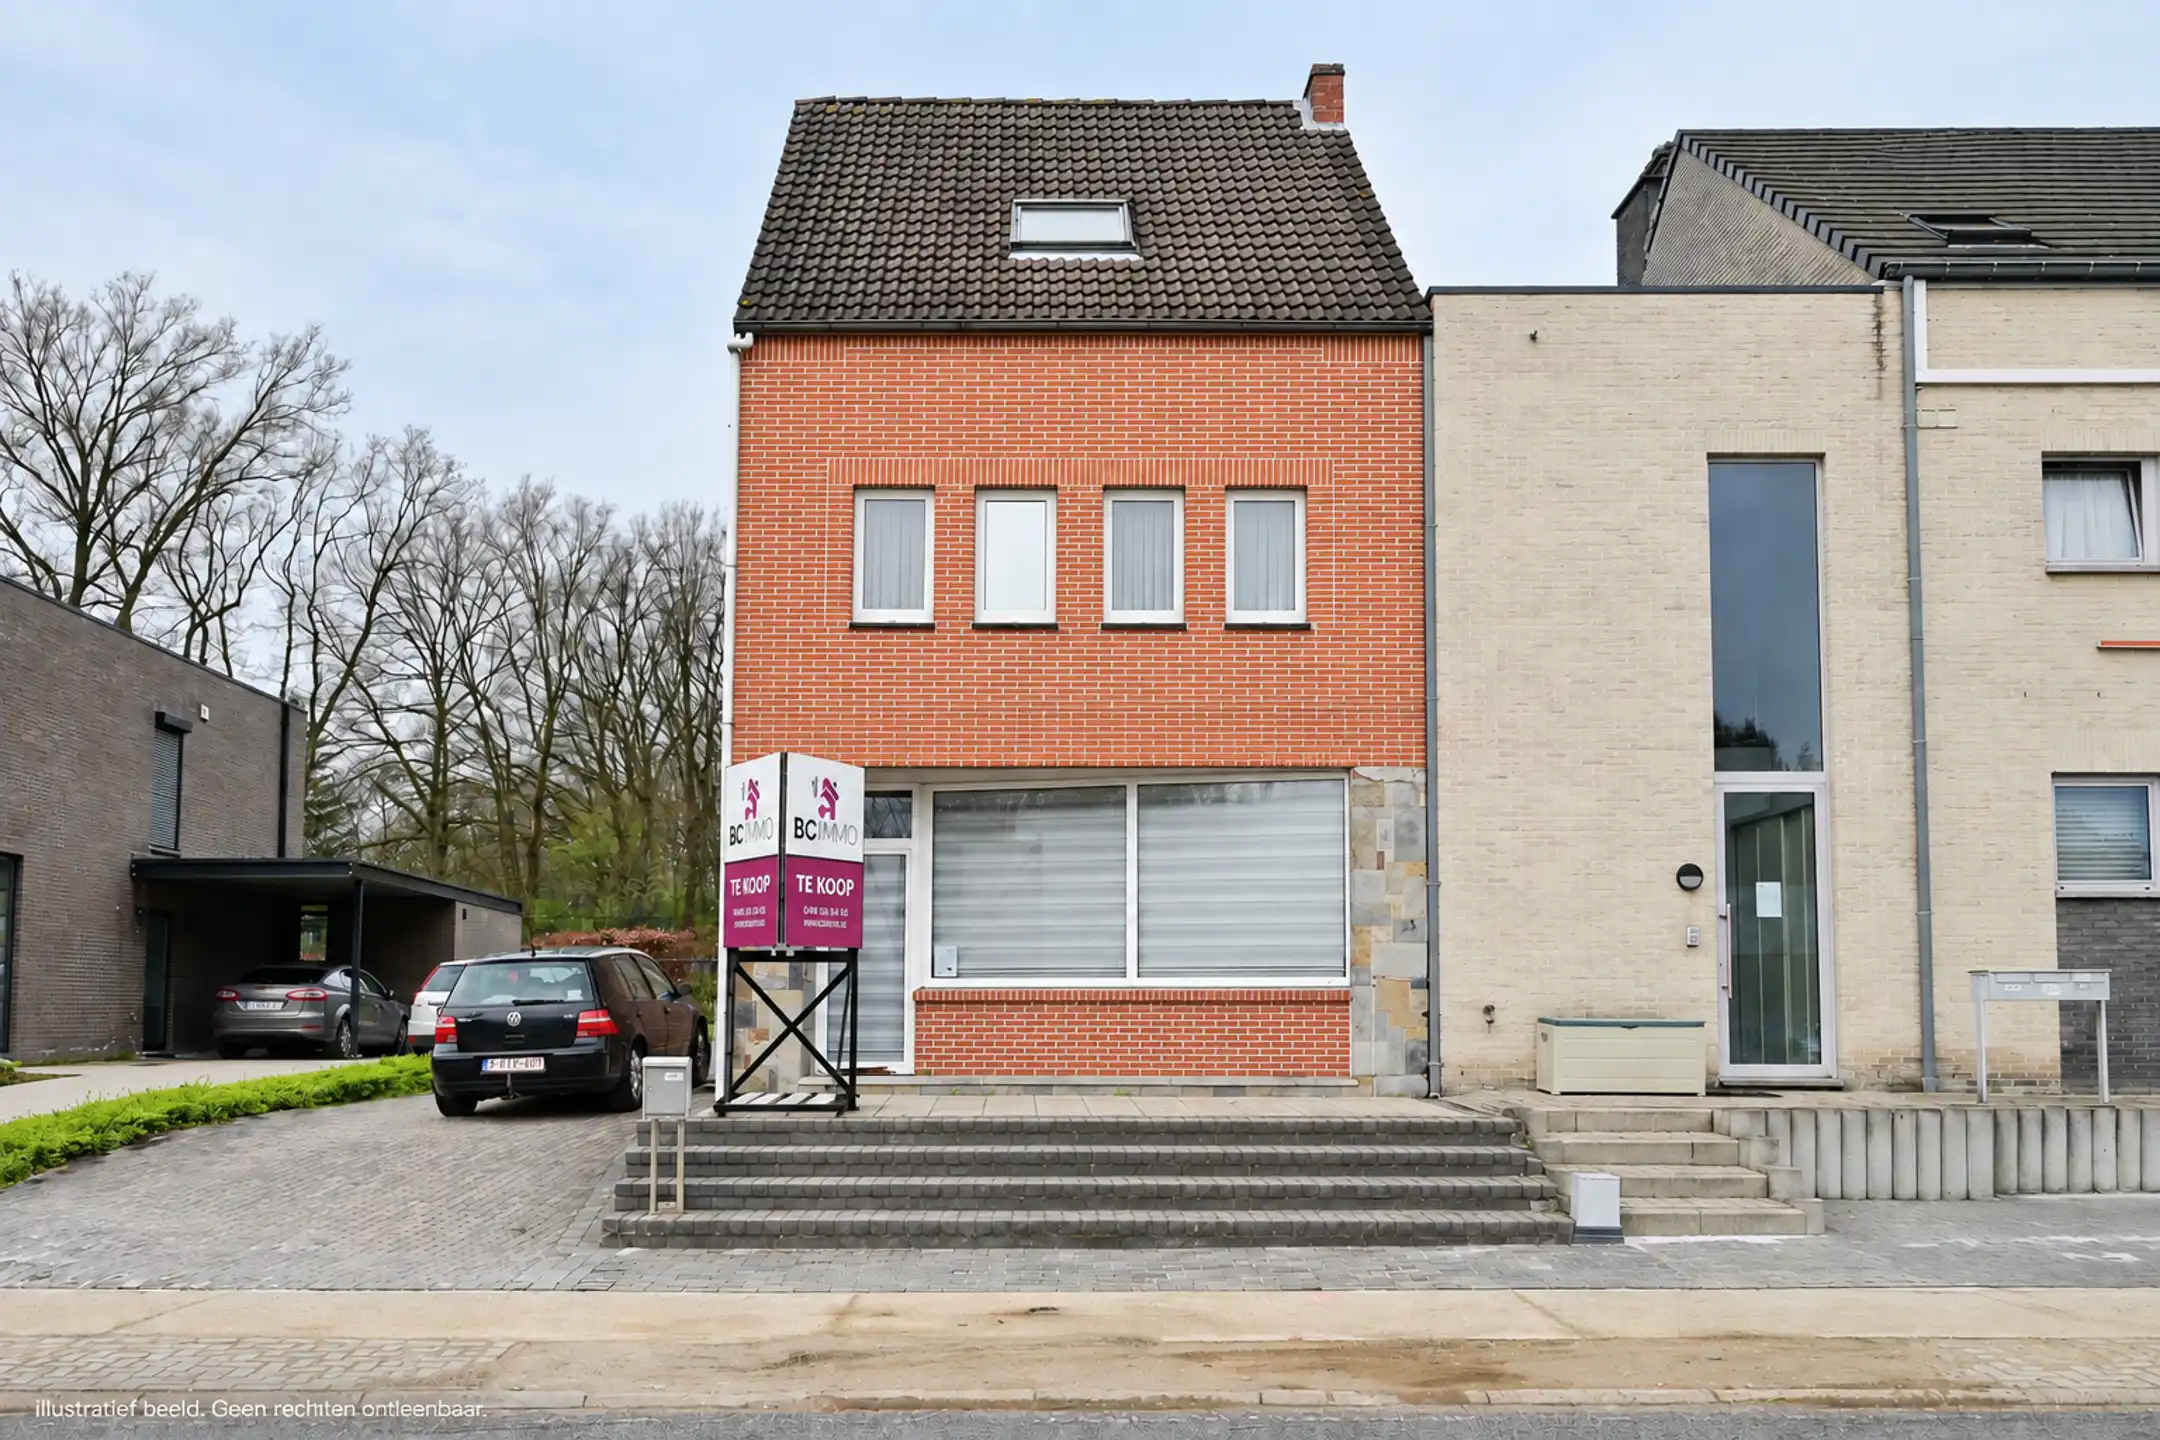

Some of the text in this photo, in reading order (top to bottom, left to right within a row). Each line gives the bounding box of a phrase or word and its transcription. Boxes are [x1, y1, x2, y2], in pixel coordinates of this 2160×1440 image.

[730, 874, 772, 897] TE KOOP
[795, 874, 855, 897] TE KOOP
